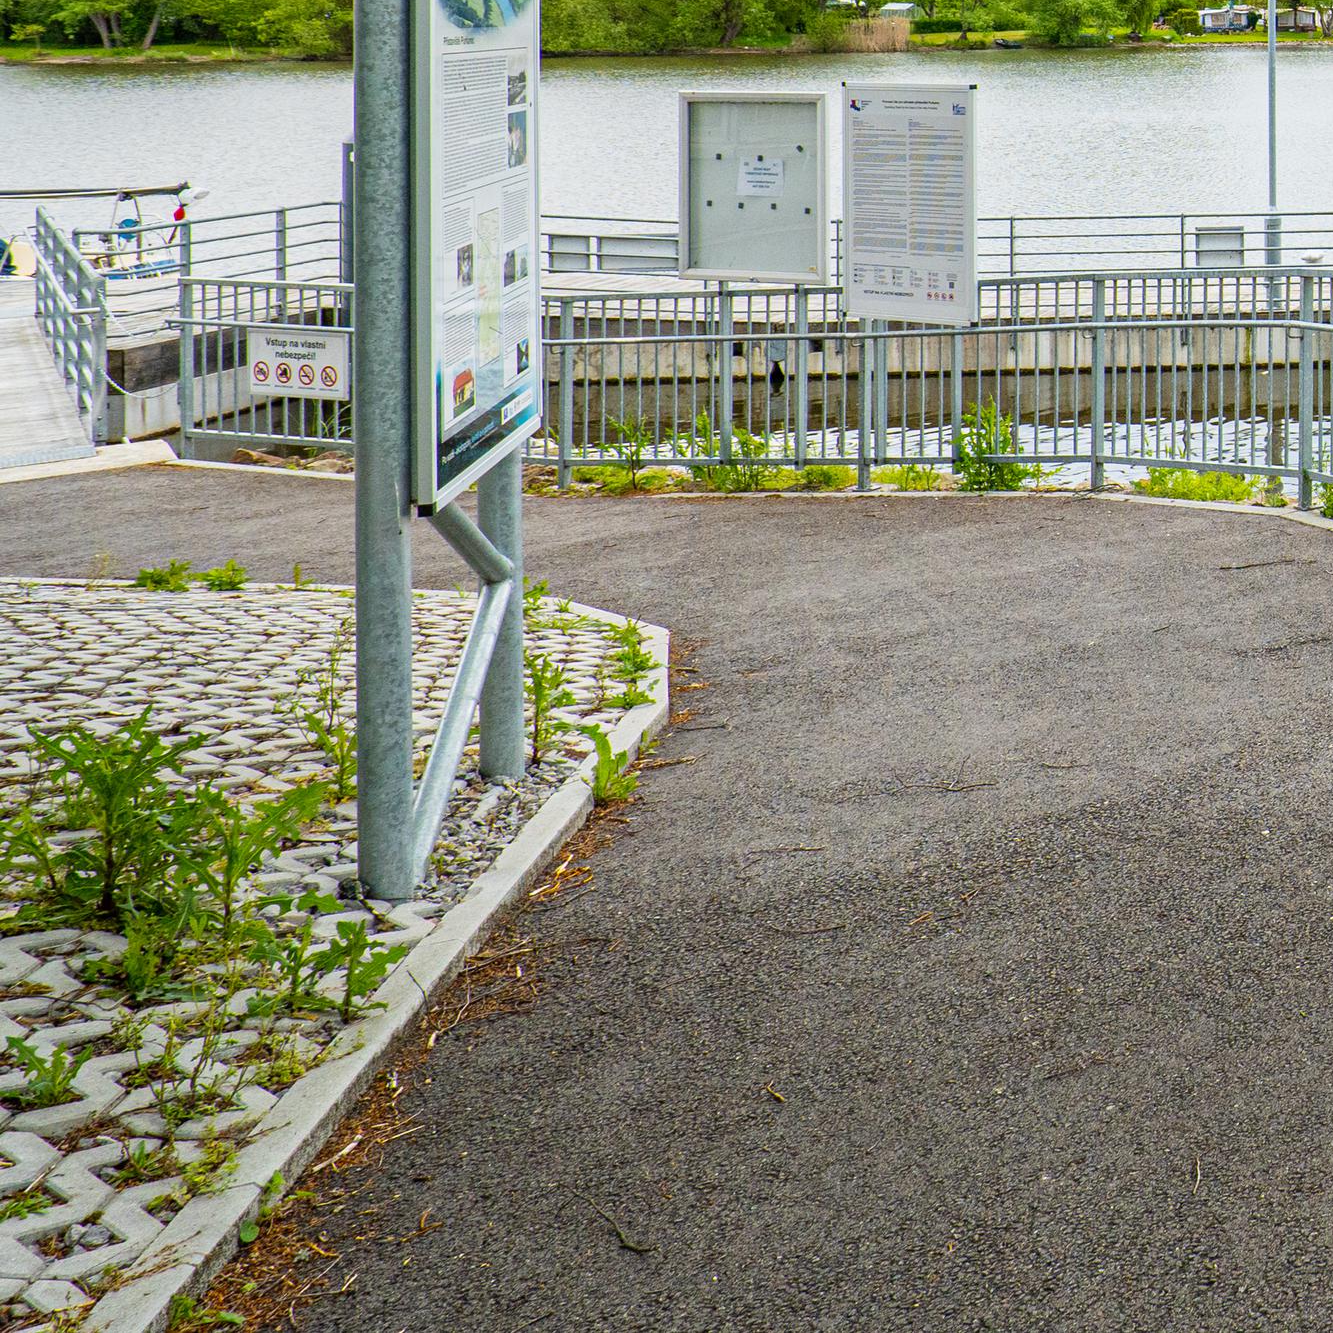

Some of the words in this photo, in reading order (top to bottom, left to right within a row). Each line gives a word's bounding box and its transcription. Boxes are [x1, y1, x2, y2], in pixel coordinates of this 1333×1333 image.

[265, 337, 287, 349] Vstup
[289, 340, 299, 348] na
[300, 339, 326, 350] vlastní
